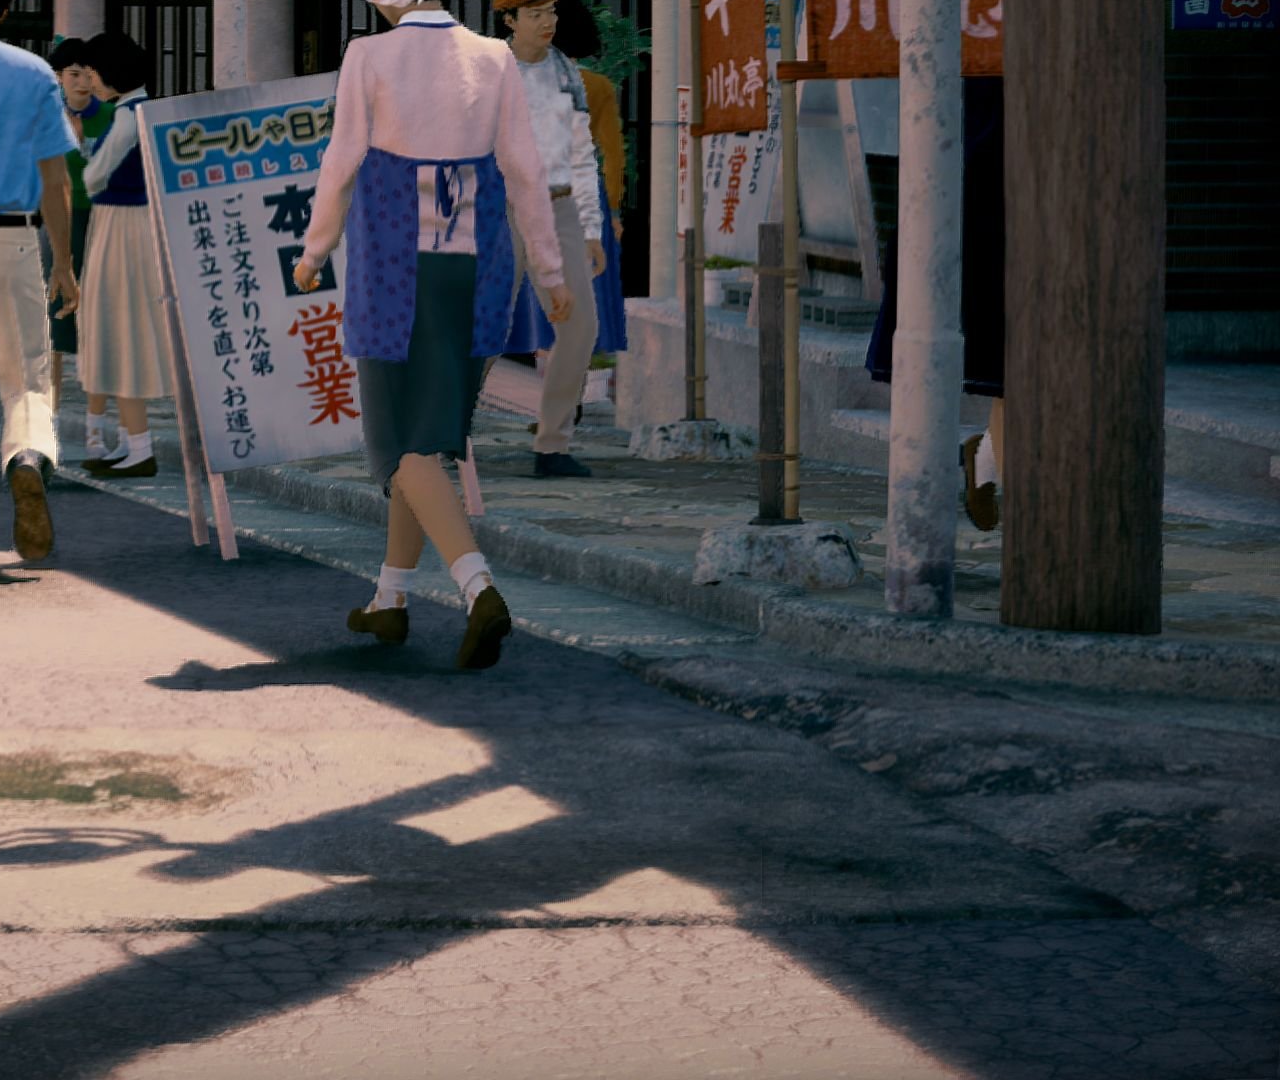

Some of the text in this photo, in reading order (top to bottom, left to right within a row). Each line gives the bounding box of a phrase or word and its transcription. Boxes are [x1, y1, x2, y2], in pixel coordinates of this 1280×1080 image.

[172, 105, 336, 158] ビールや日本
[706, 55, 766, 110] 川丸亭
[188, 199, 257, 460] 出来立てを直ぐお運び
[222, 194, 274, 376] ご注文承り次第
[288, 302, 360, 426] 営業
